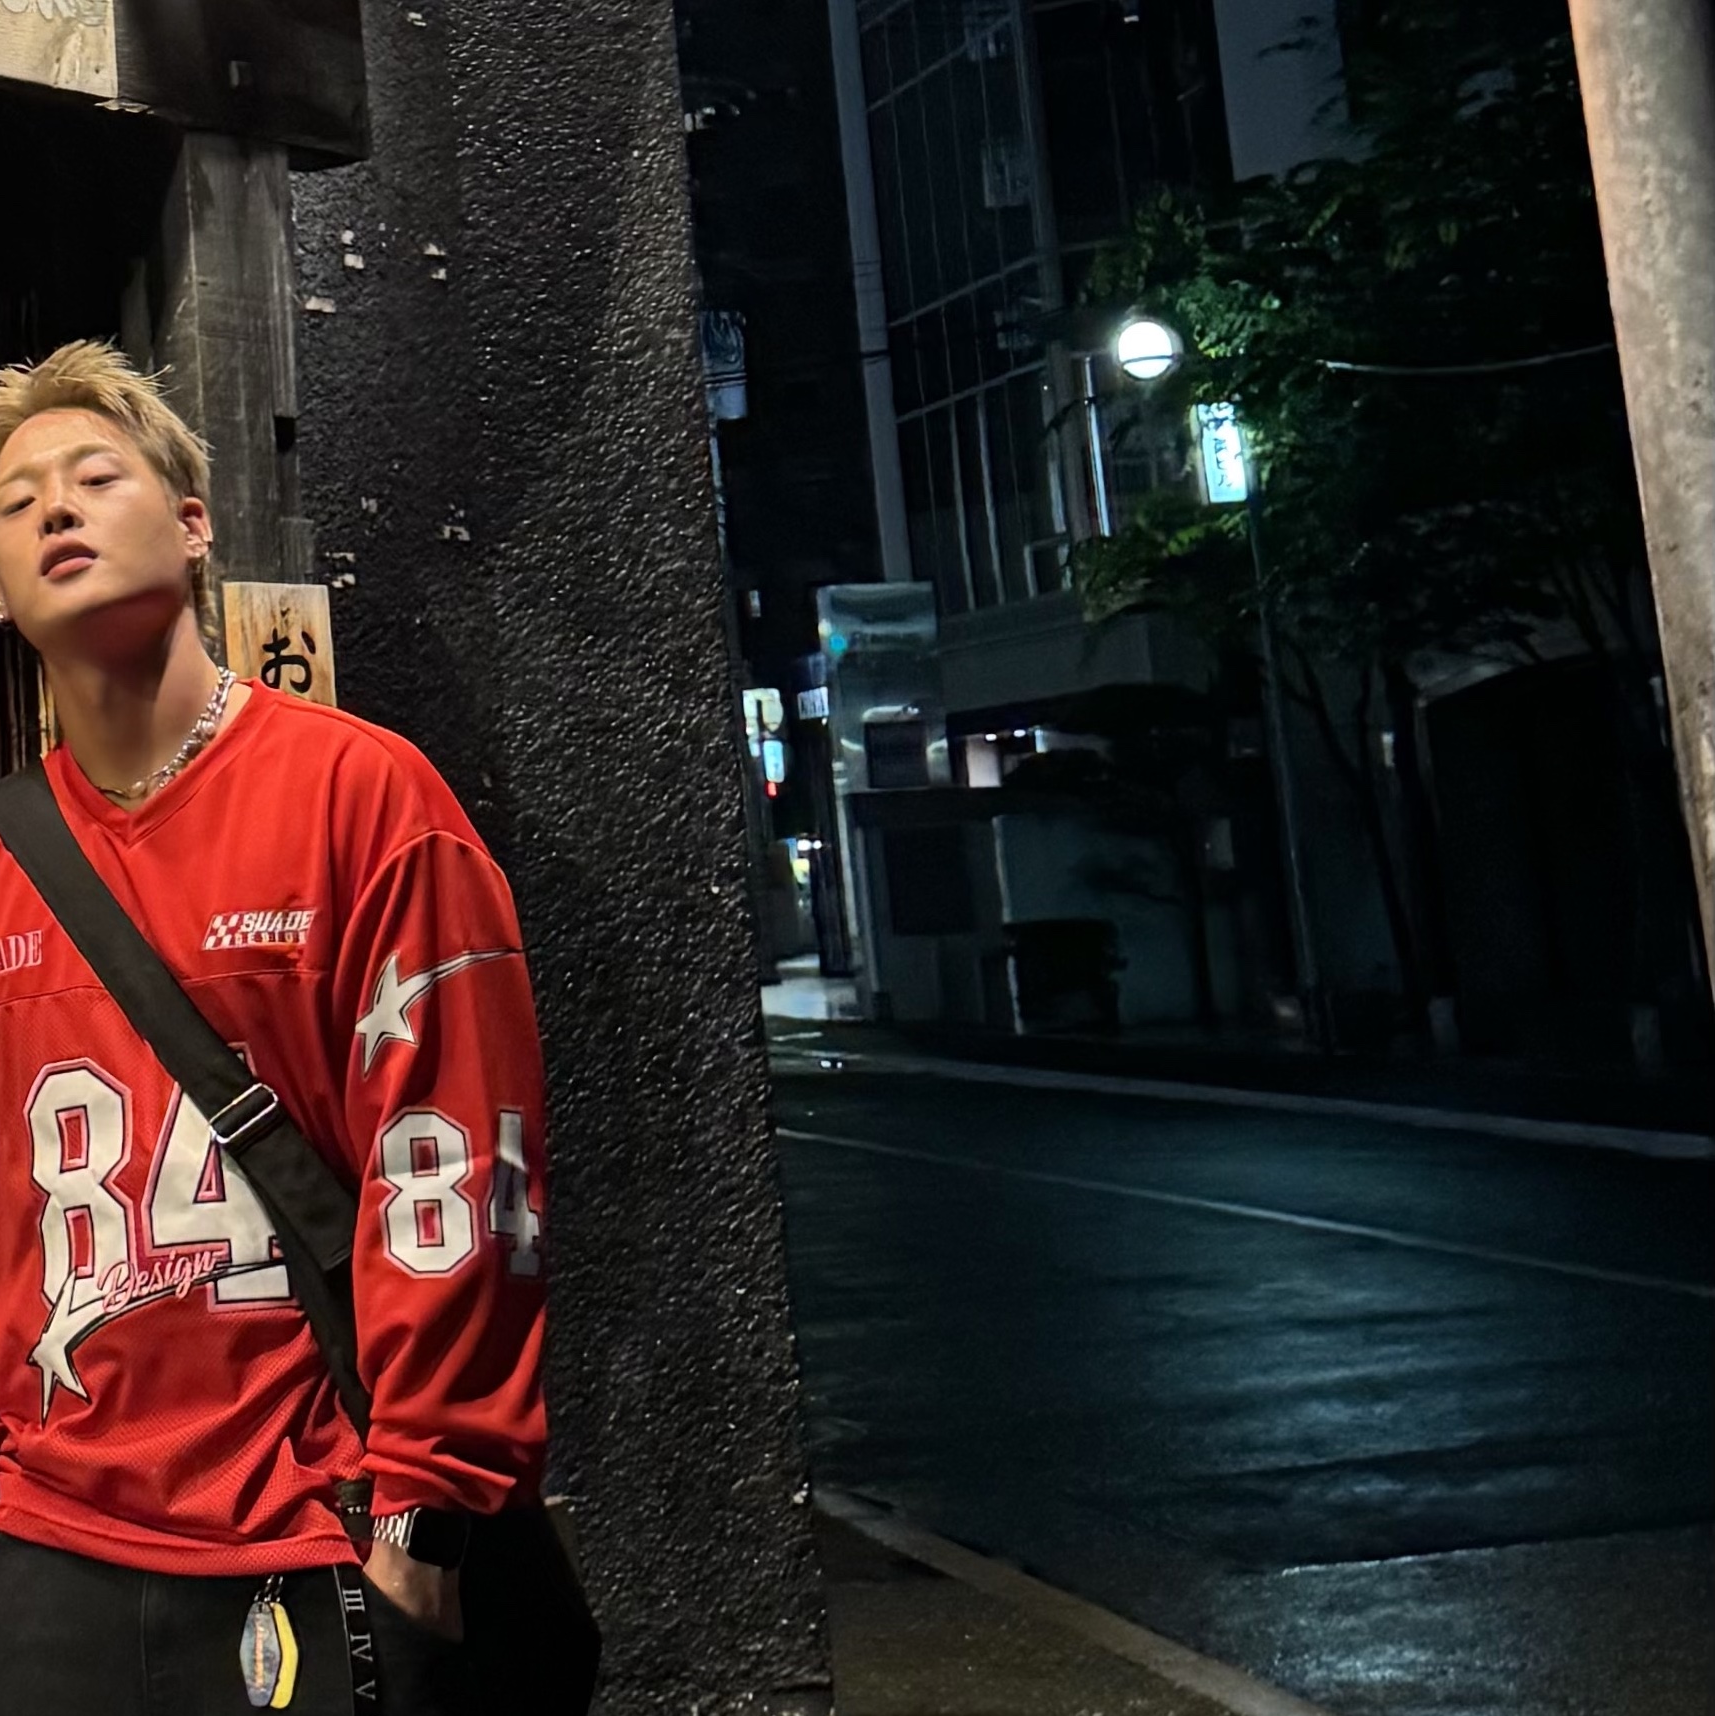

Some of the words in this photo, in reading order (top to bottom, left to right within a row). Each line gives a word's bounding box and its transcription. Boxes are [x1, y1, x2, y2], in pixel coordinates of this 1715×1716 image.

[240, 908, 316, 933] SUADE
[25, 1041, 303, 1313] 84
[379, 1105, 542, 1280] 84
[96, 1251, 226, 1312] Design
